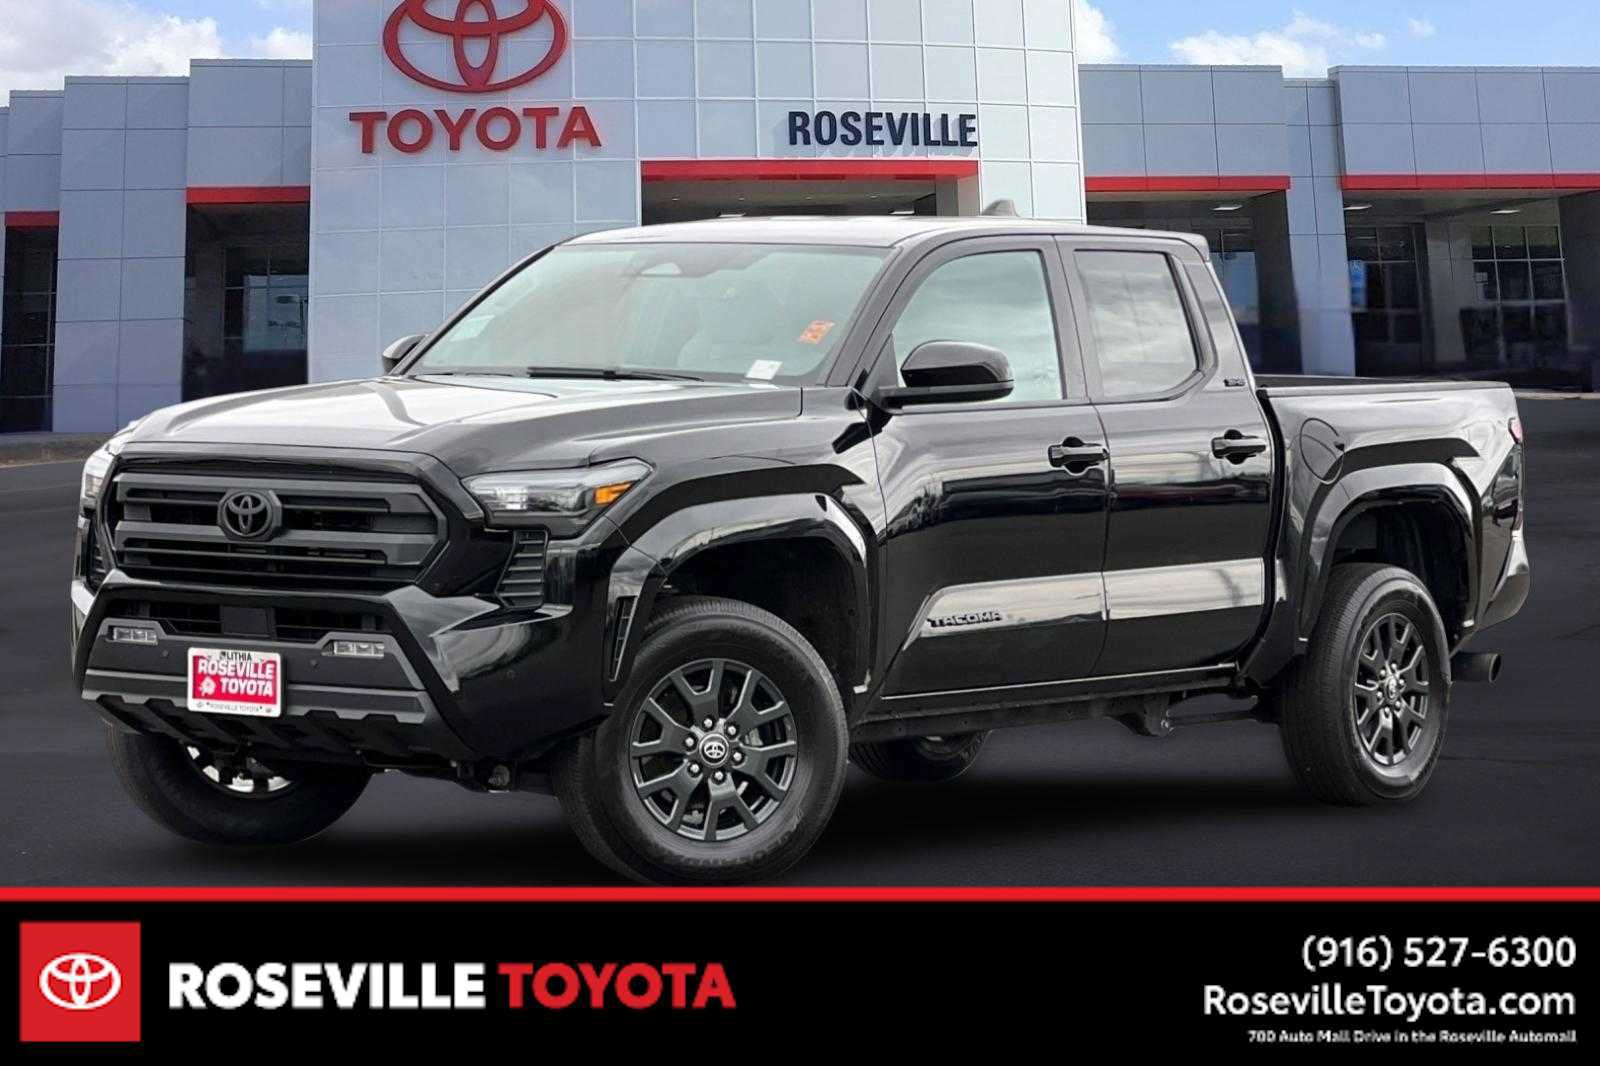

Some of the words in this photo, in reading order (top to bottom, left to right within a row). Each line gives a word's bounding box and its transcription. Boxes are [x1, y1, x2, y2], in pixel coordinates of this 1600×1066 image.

[349, 106, 603, 154] TOYOTA
[788, 110, 979, 147] ROSEVILLE
[926, 611, 1003, 628] TACOMA
[226, 651, 252, 662] LITHIA
[197, 657, 276, 680] ROSEVILLE
[220, 678, 274, 698] TOYOTA
